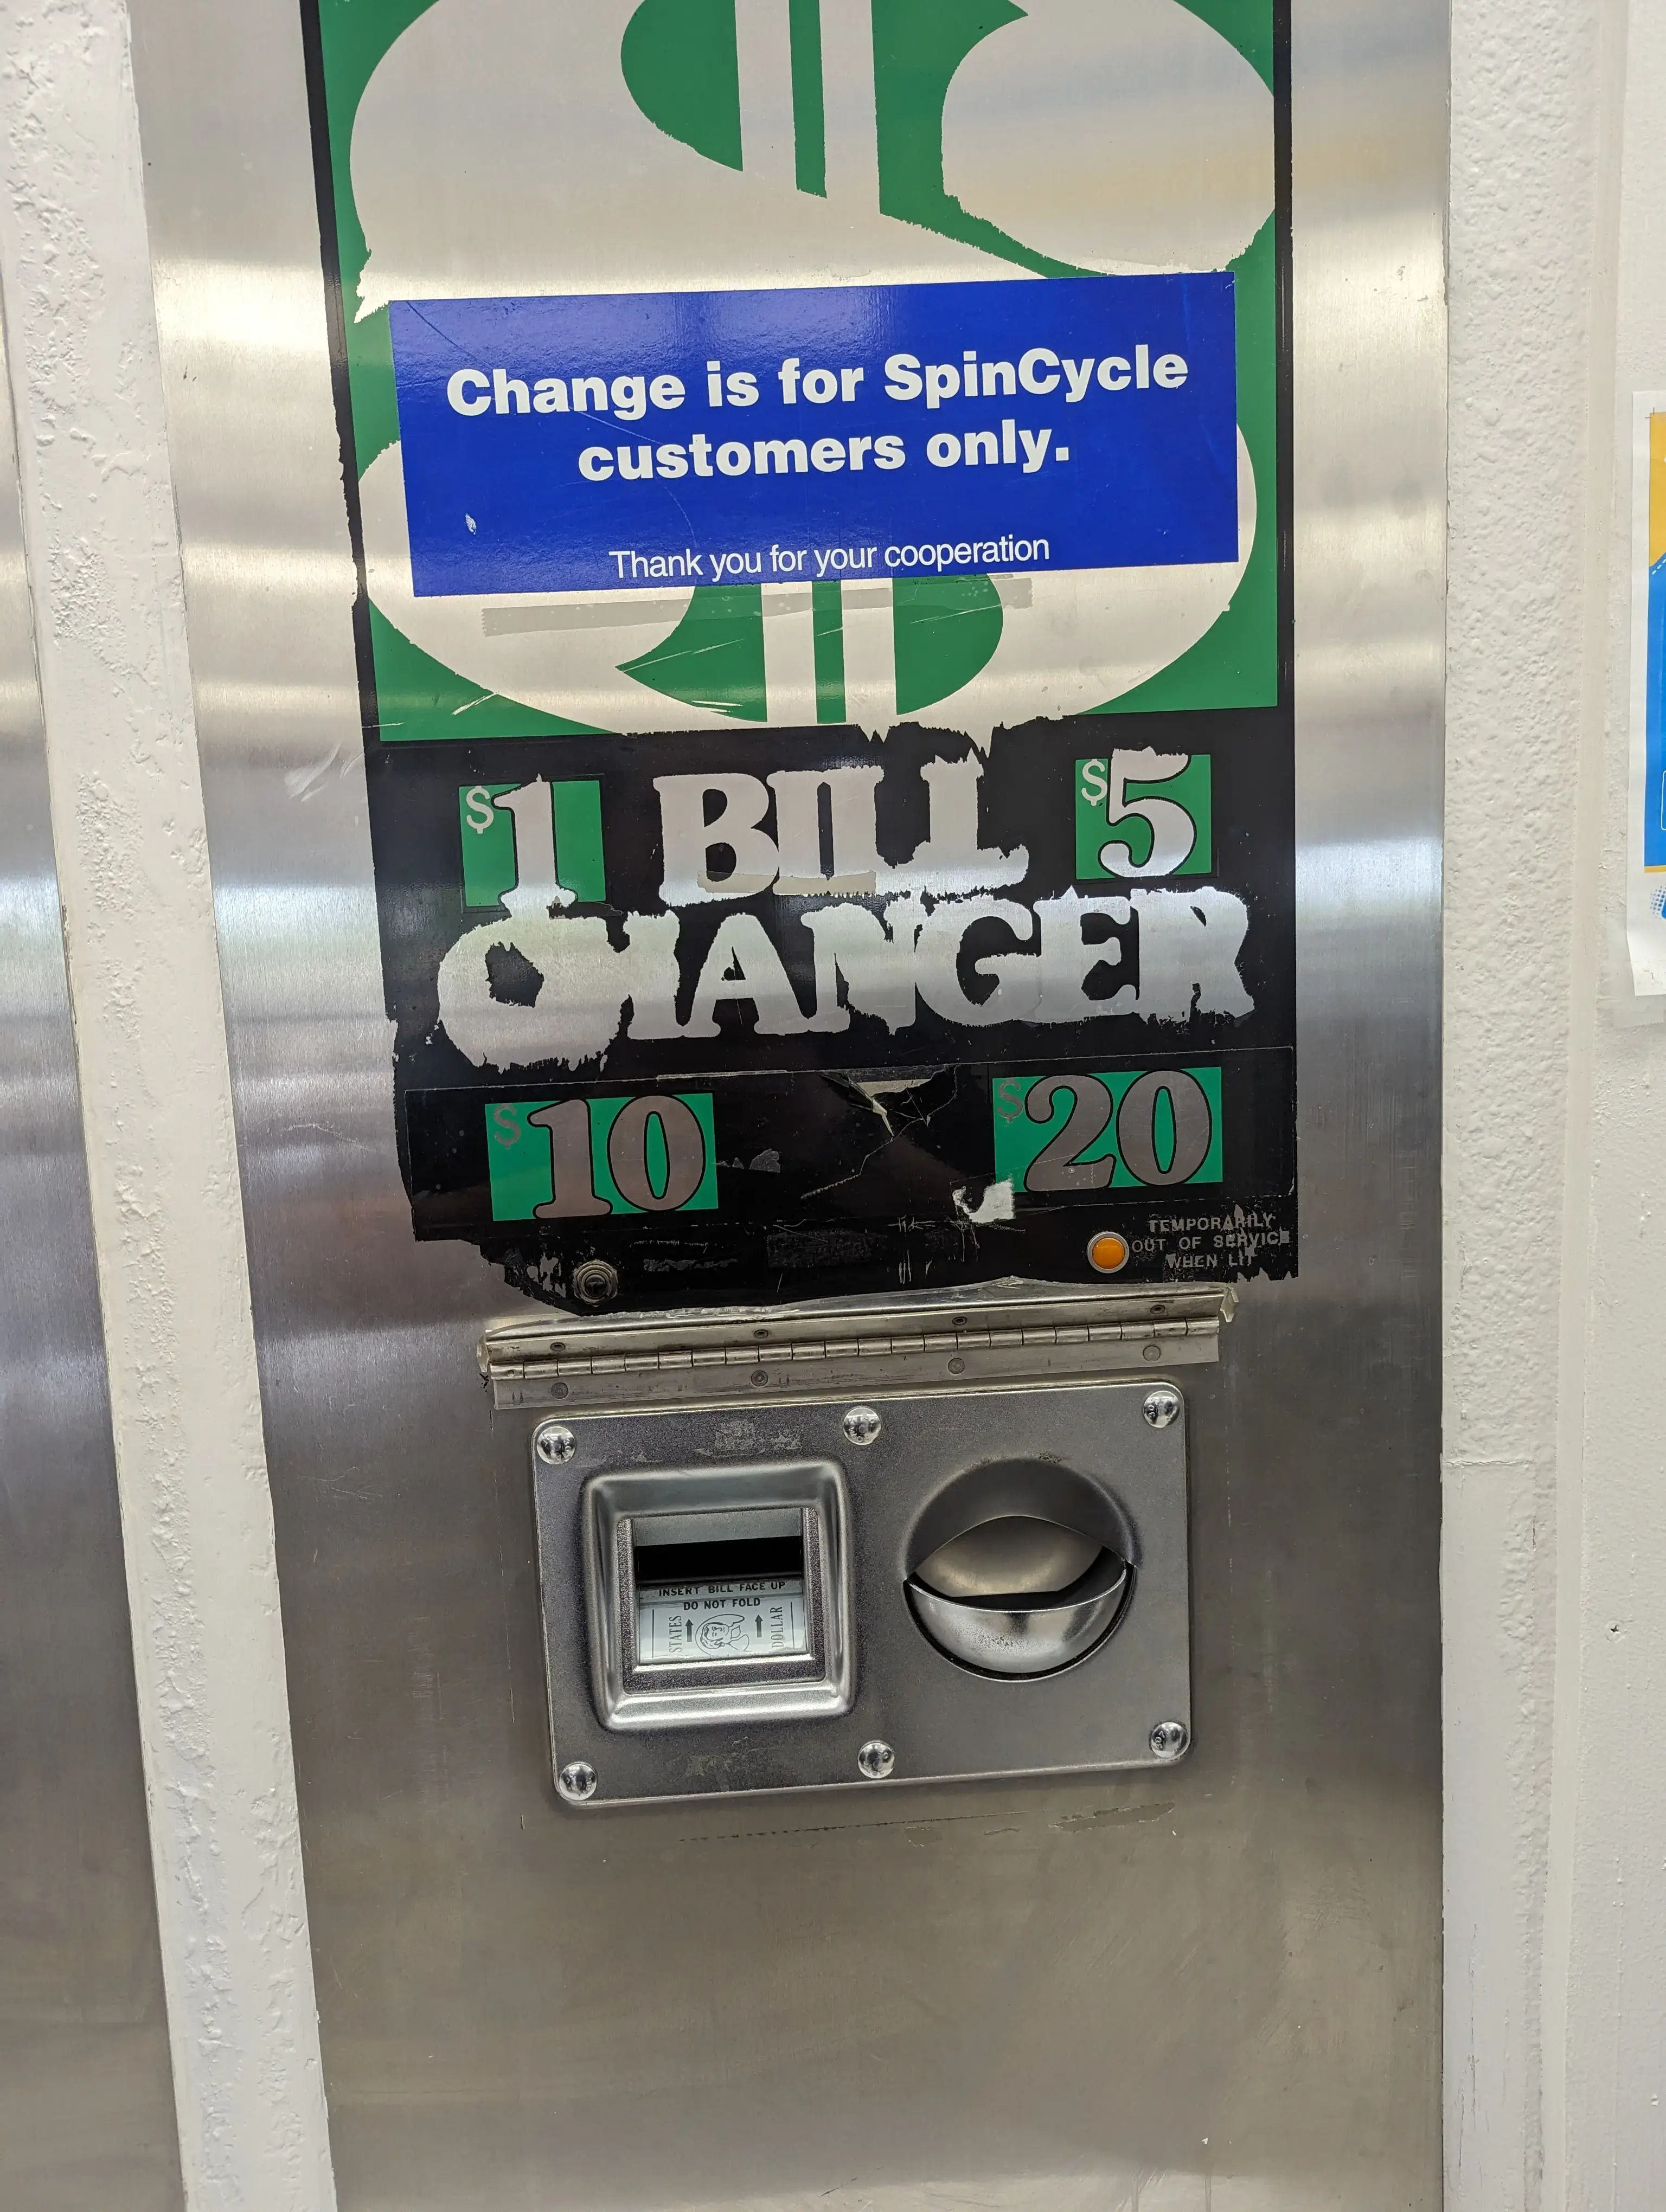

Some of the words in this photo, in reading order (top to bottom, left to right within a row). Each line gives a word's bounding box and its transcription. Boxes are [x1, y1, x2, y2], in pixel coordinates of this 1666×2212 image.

[447, 368, 685, 421] Change
[707, 360, 759, 407] is
[778, 357, 864, 404] for
[885, 344, 1188, 409] SpinCycle
[578, 434, 906, 481] customers
[926, 419, 1069, 473] only.
[608, 548, 704, 578] Thank
[709, 552, 762, 581] you
[769, 544, 808, 572] for
[813, 546, 877, 578] your
[884, 536, 1049, 573] cooperation
[1081, 747, 1196, 878] $5
[997, 1070, 1213, 1192] $20
[494, 1095, 706, 1219] $10
[1131, 1238, 1167, 1253] OUT
[1178, 1236, 1202, 1250] OF
[1213, 1229, 1290, 1249] SERVICE
[1148, 1212, 1276, 1232] TEMPORARILY
[1165, 1254, 1218, 1269] WHEN
[658, 1586, 700, 1597] INSERT
[708, 1584, 733, 1594] BILL
[739, 1583, 766, 1592] FACE
[771, 1581, 786, 1590] UP
[683, 1601, 699, 1611] DO
[704, 1599, 726, 1610] NOT
[732, 1597, 761, 1607] FOLD
[669, 1615, 682, 1653] STATES
[770, 1606, 784, 1648] DOLLAR
